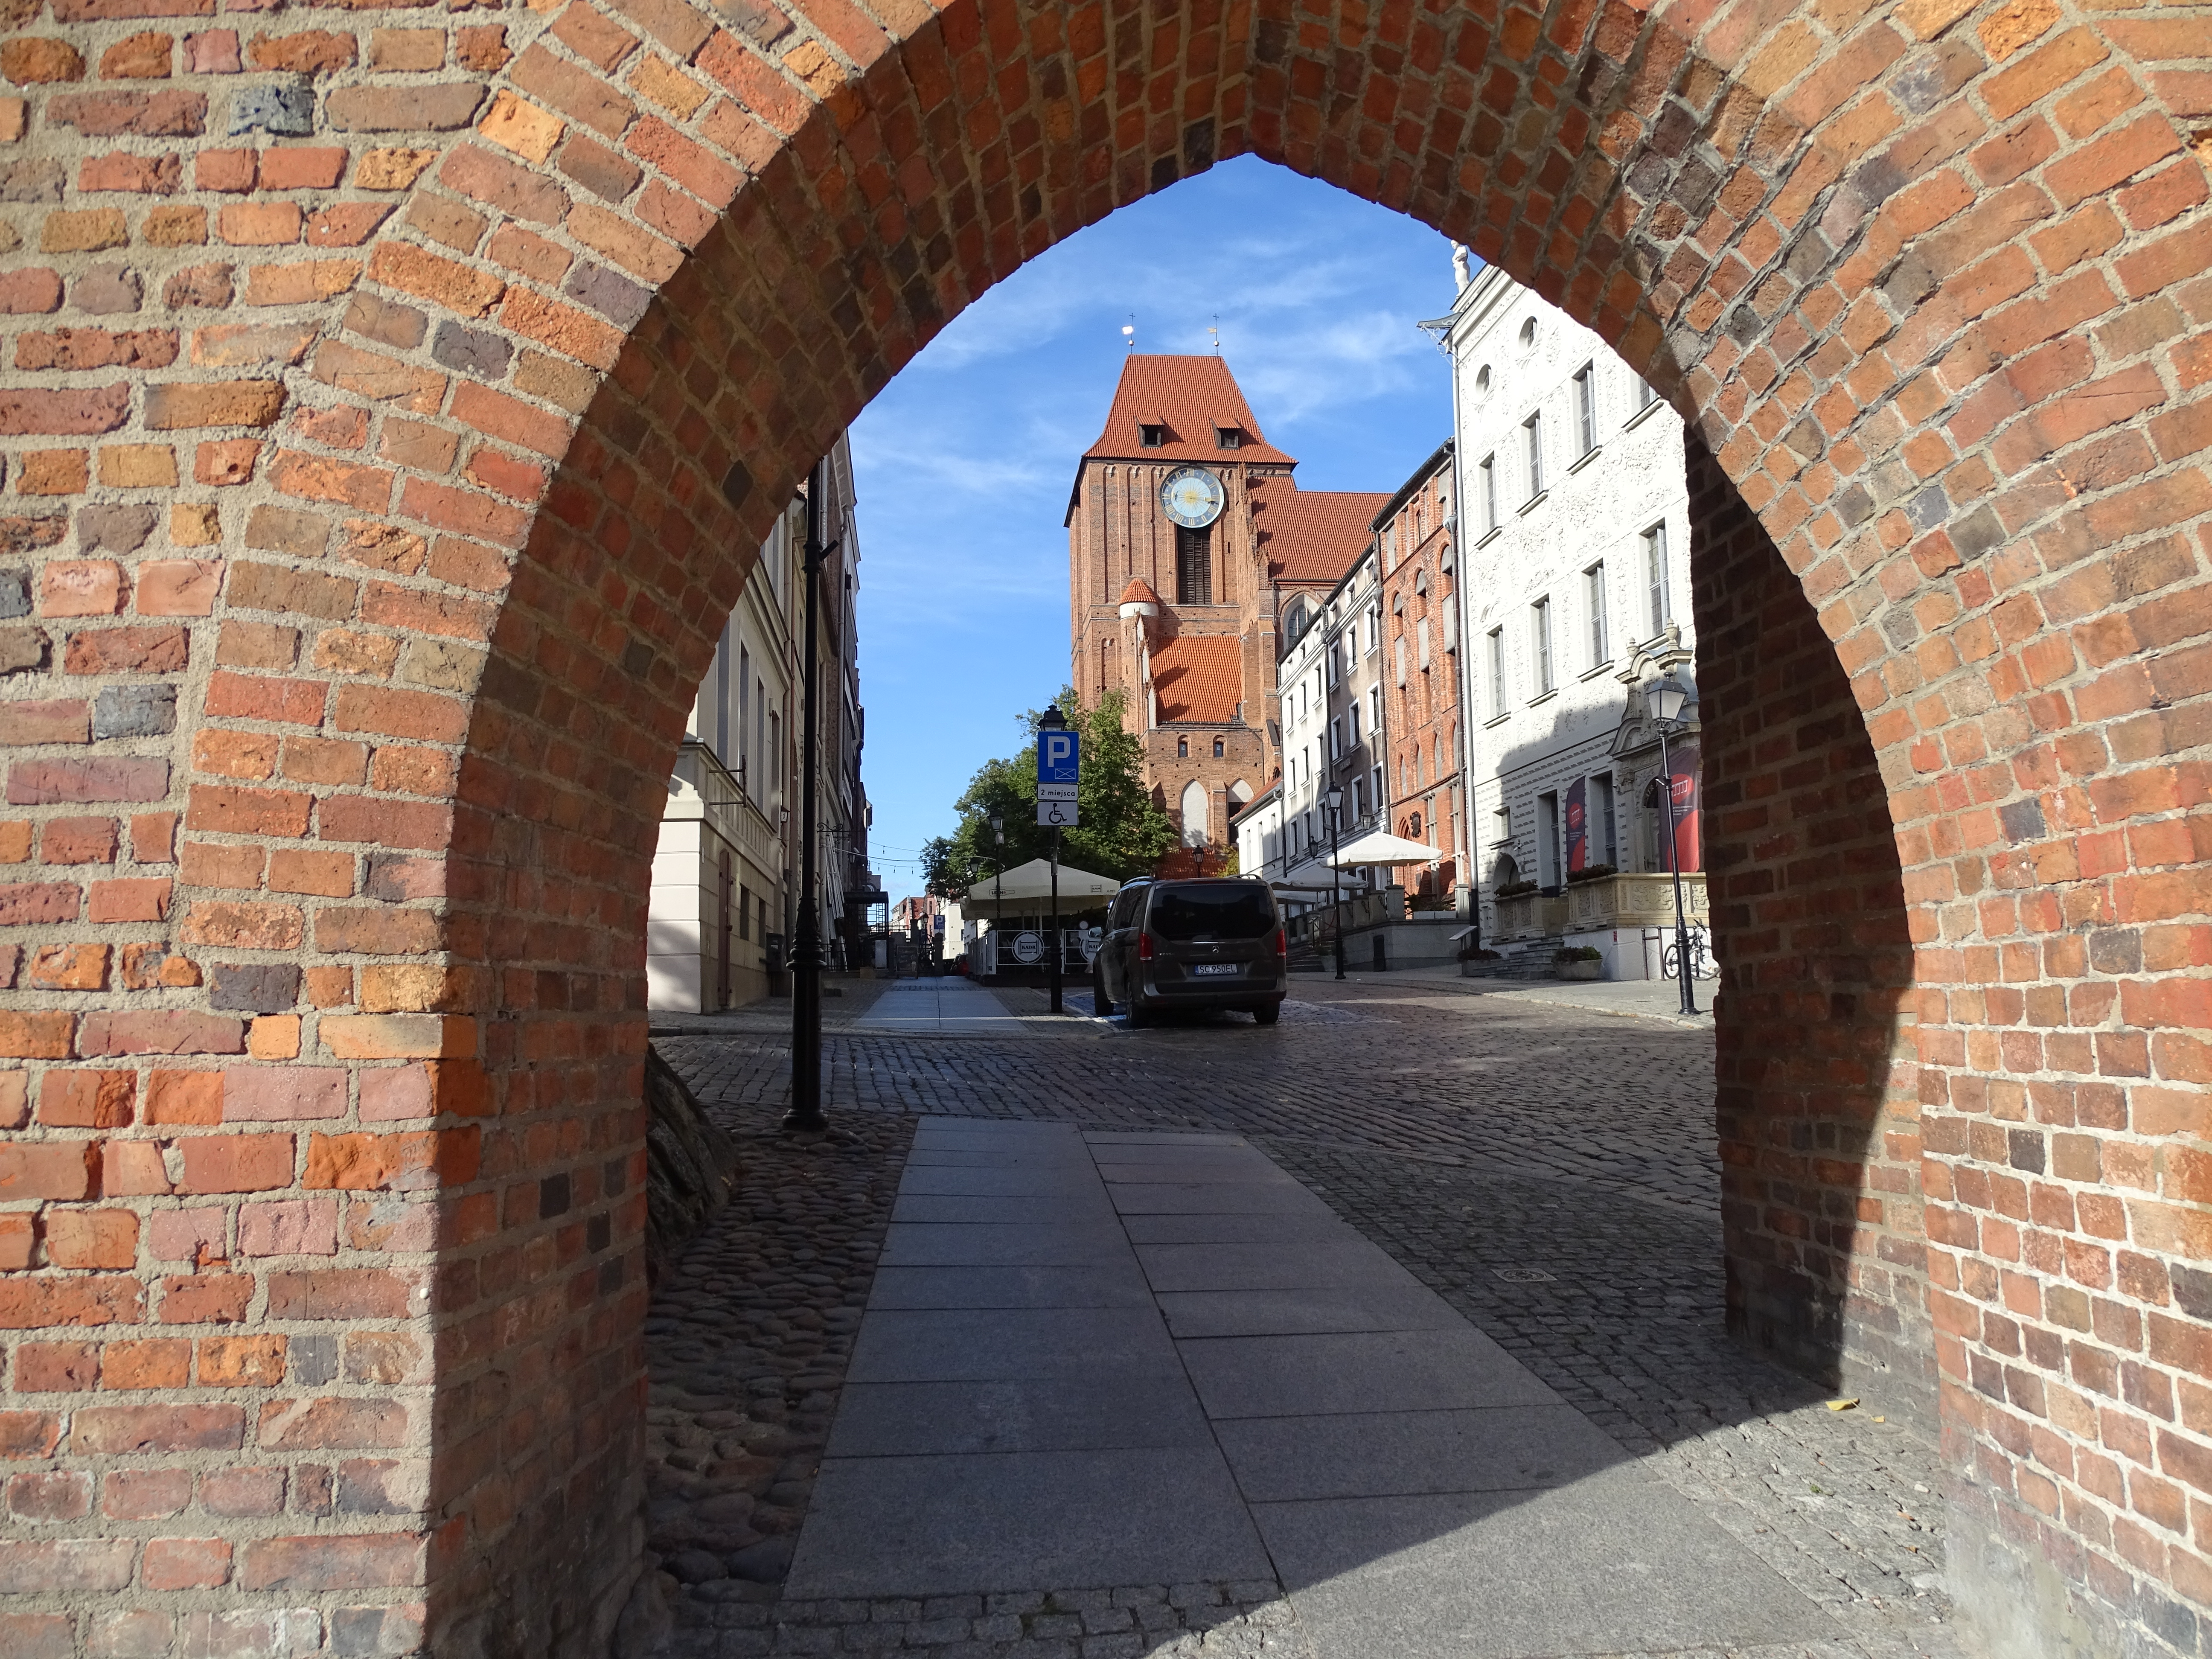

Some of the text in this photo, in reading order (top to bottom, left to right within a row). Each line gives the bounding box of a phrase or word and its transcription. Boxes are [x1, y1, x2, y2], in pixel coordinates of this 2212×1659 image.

[1048, 736, 1071, 767] P
[1048, 789, 1075, 797] miejsca
[936, 916, 943, 925] P
[1212, 964, 1235, 972] 950EL
